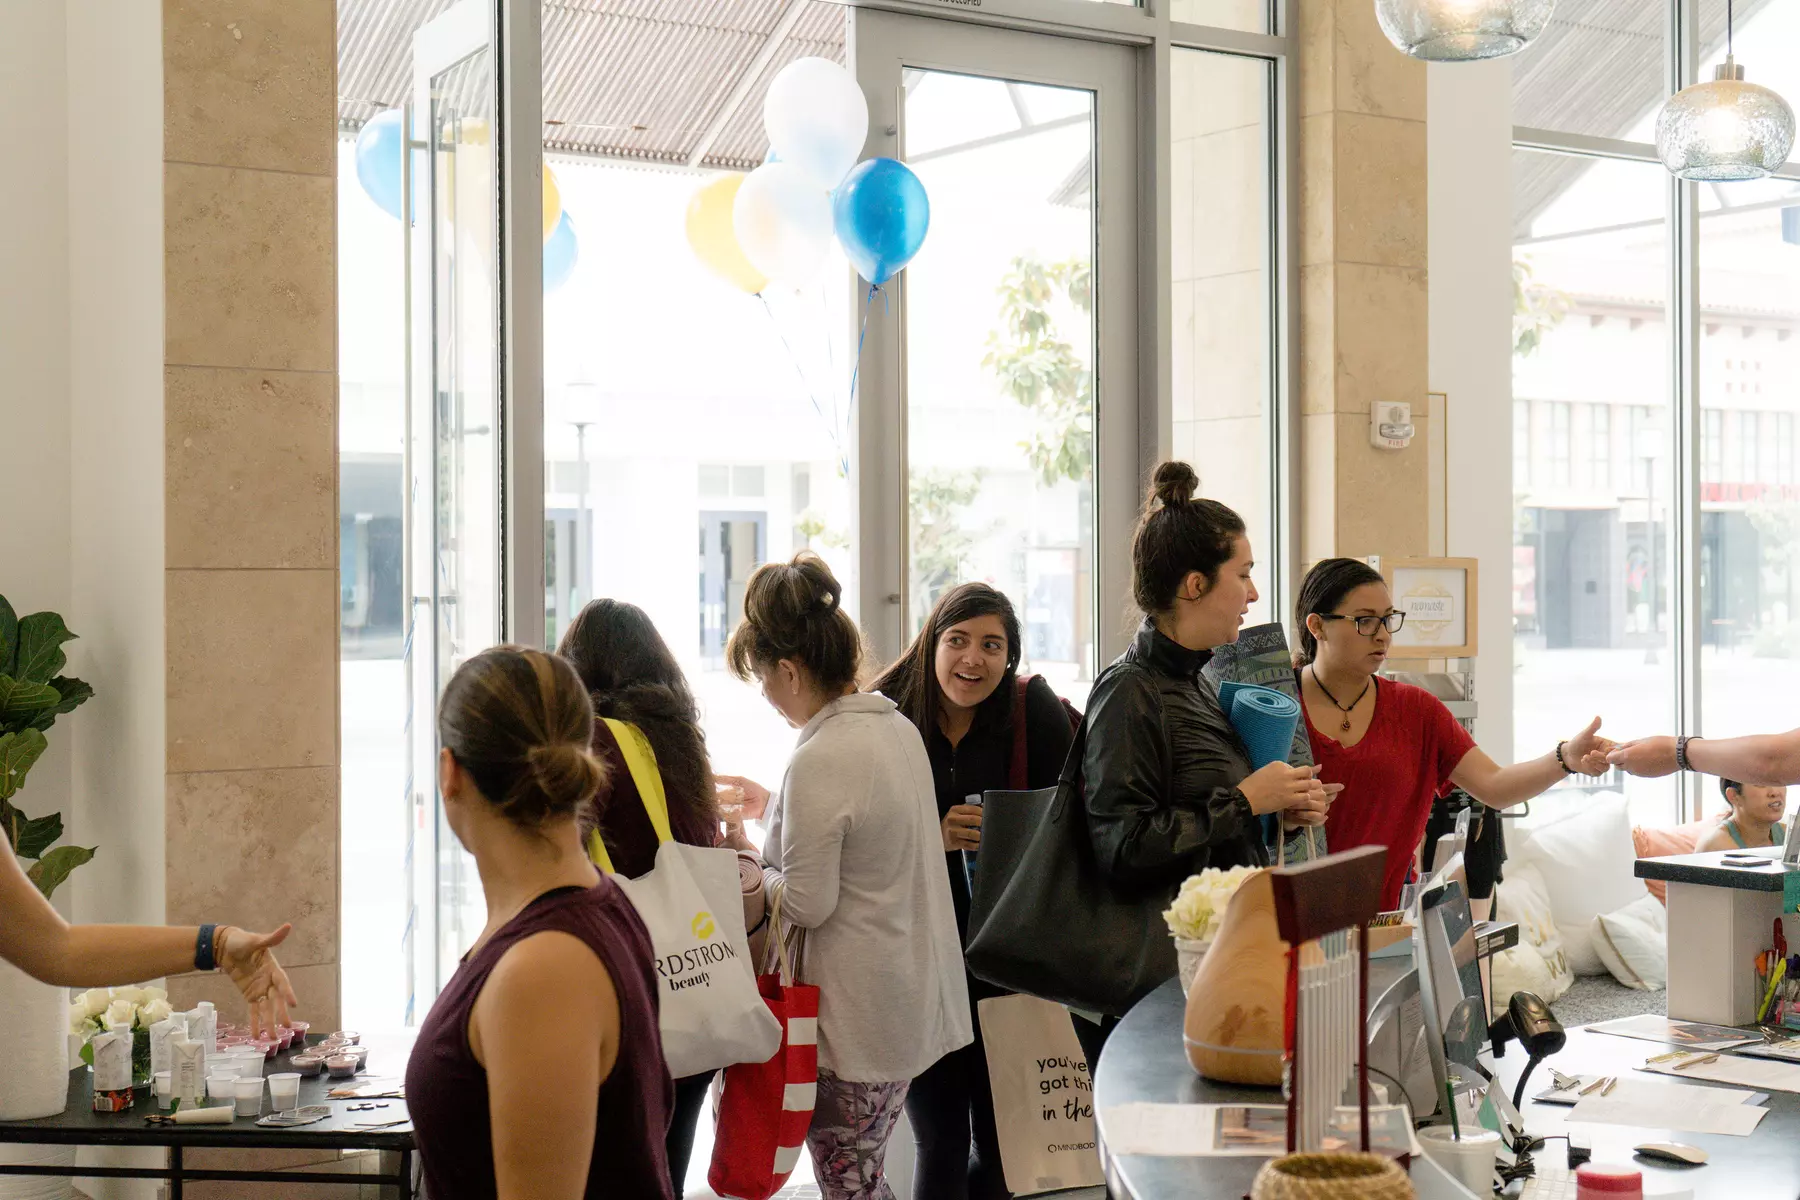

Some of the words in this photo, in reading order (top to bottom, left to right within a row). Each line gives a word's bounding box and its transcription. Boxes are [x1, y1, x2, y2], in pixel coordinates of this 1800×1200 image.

[655, 941, 738, 977] RDSTROM
[668, 971, 711, 992] beauty
[1036, 1056, 1087, 1073] you've
[1040, 1075, 1069, 1094] got
[1073, 1076, 1093, 1092] thi
[1042, 1104, 1057, 1121] in
[1063, 1096, 1093, 1122] the
[1057, 1142, 1096, 1151] MINDBOD
